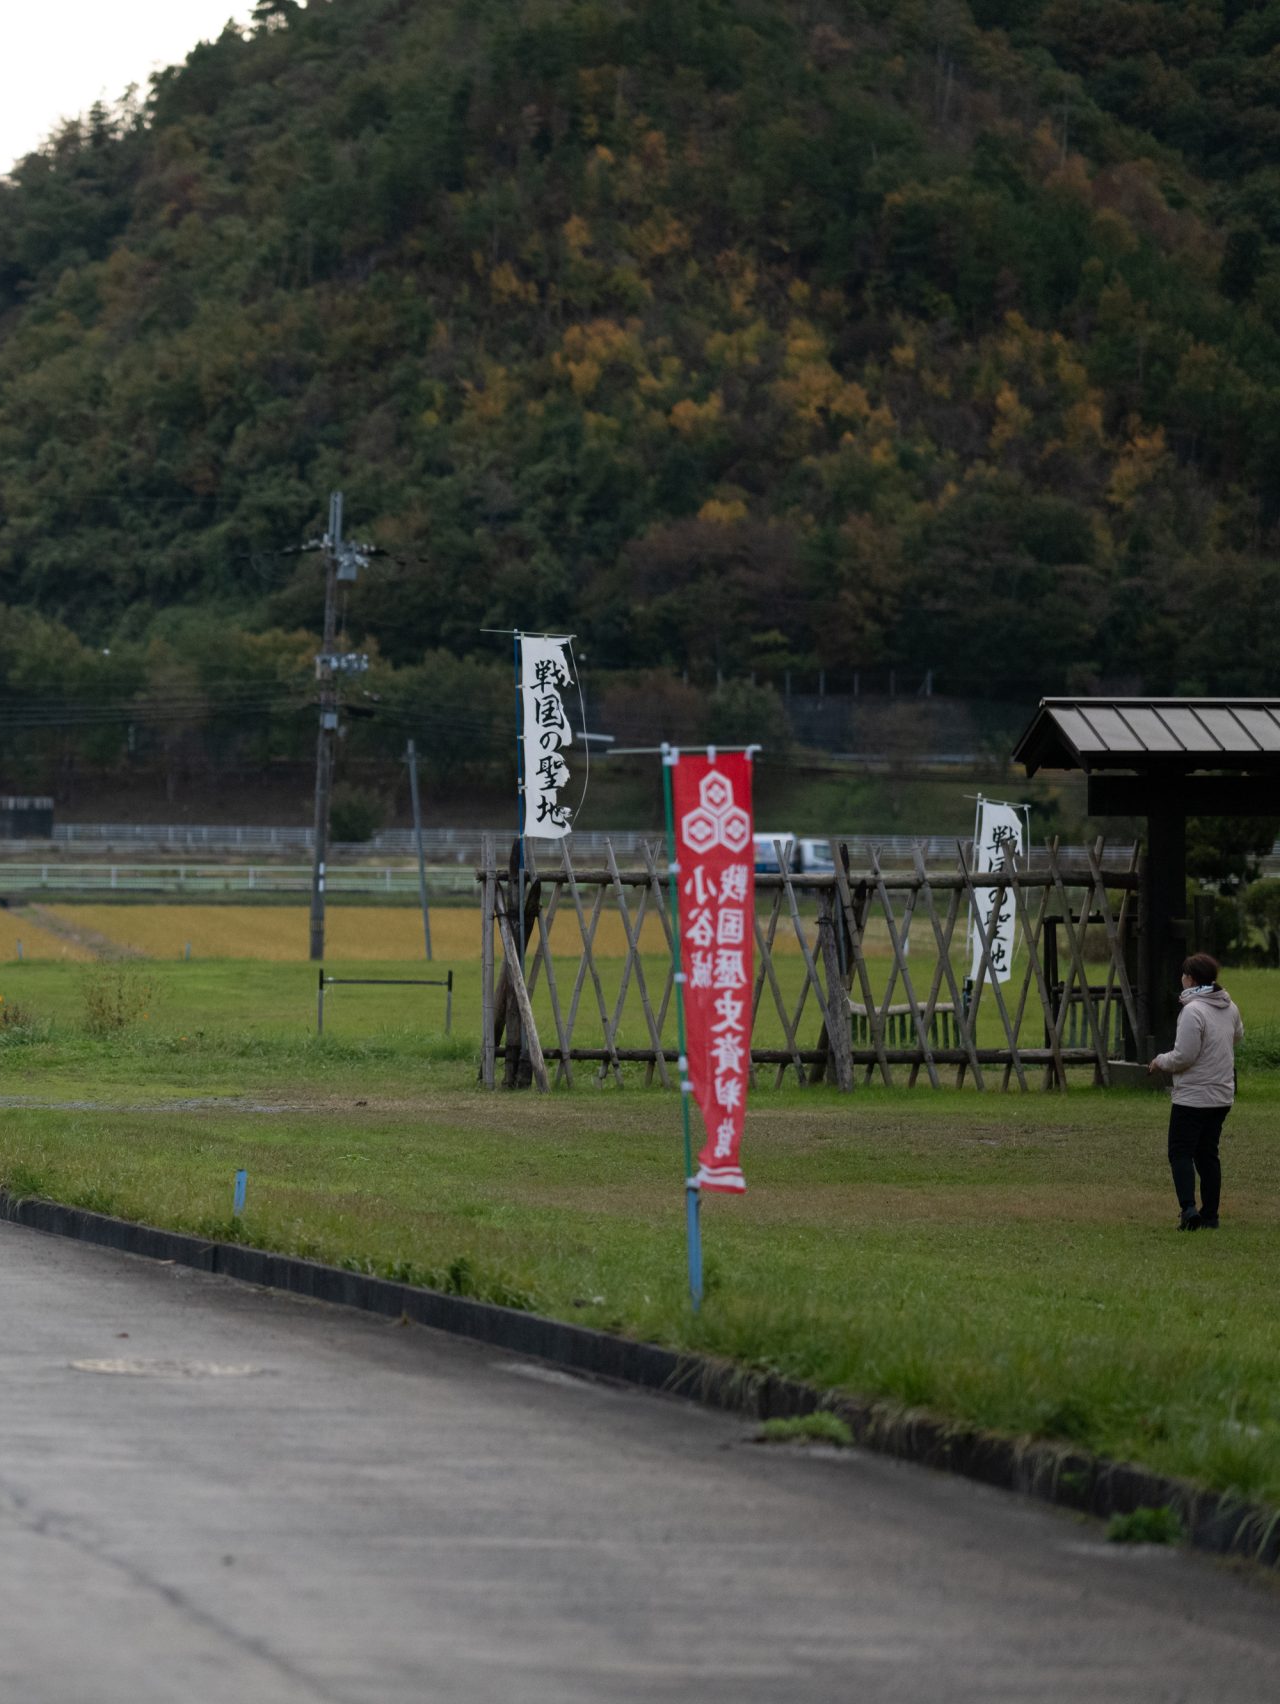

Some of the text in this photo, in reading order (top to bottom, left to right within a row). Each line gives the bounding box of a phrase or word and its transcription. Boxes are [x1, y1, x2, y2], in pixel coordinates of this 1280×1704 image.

[530, 659, 566, 829] 戦国の聖地
